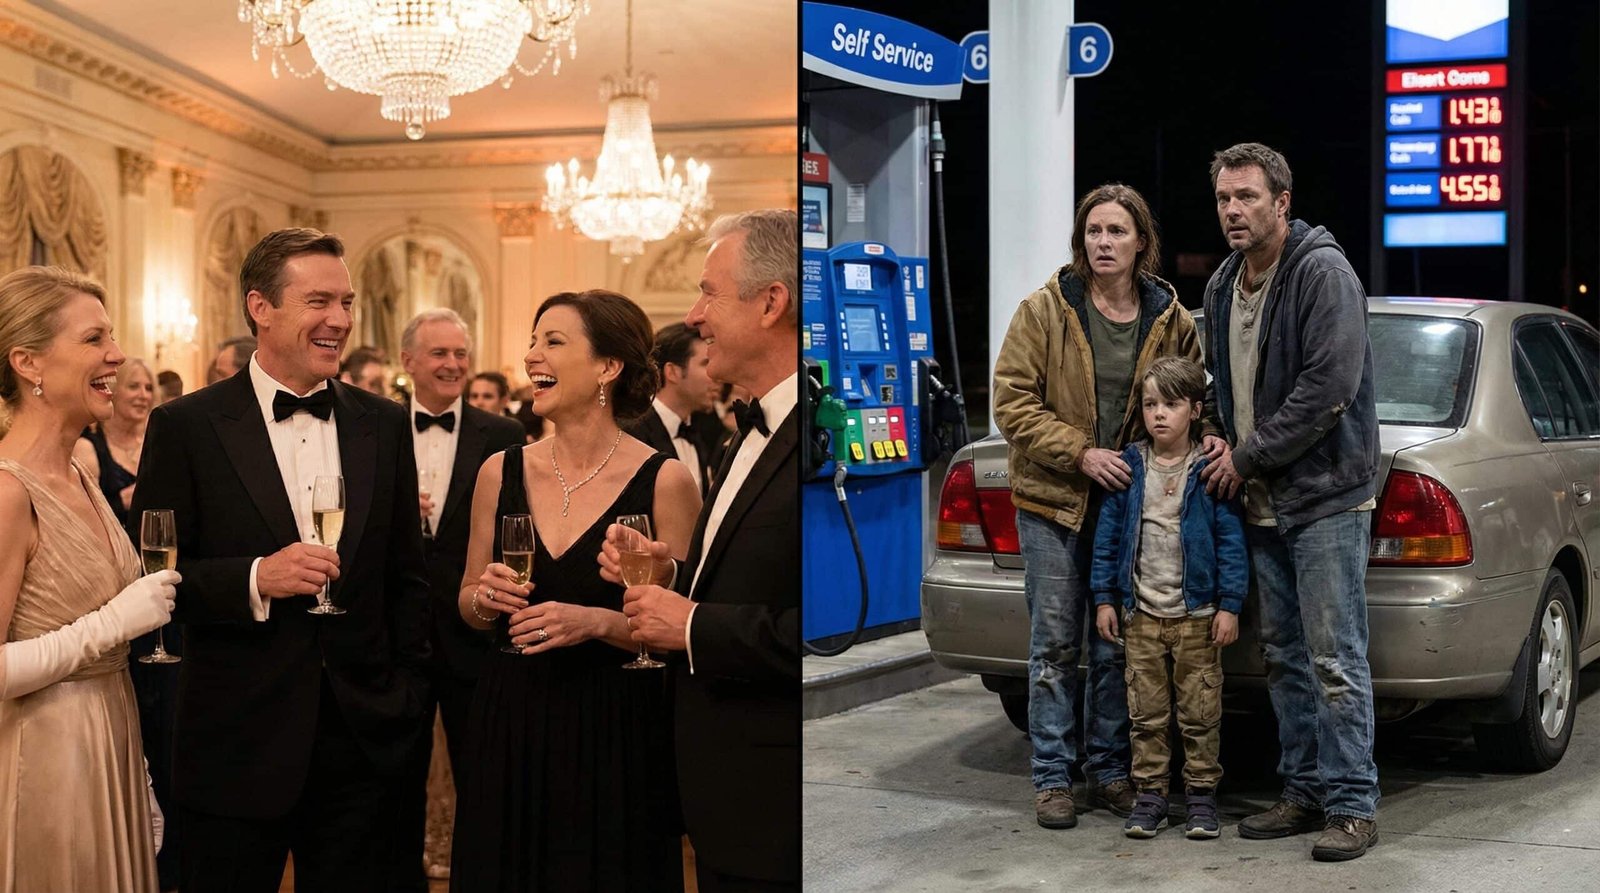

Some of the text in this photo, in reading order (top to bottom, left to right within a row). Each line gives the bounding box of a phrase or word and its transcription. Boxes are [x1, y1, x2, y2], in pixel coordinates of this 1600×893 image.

[831, 22, 934, 73] Self Service
[970, 44, 988, 71] 6
[1079, 36, 1098, 63] 6
